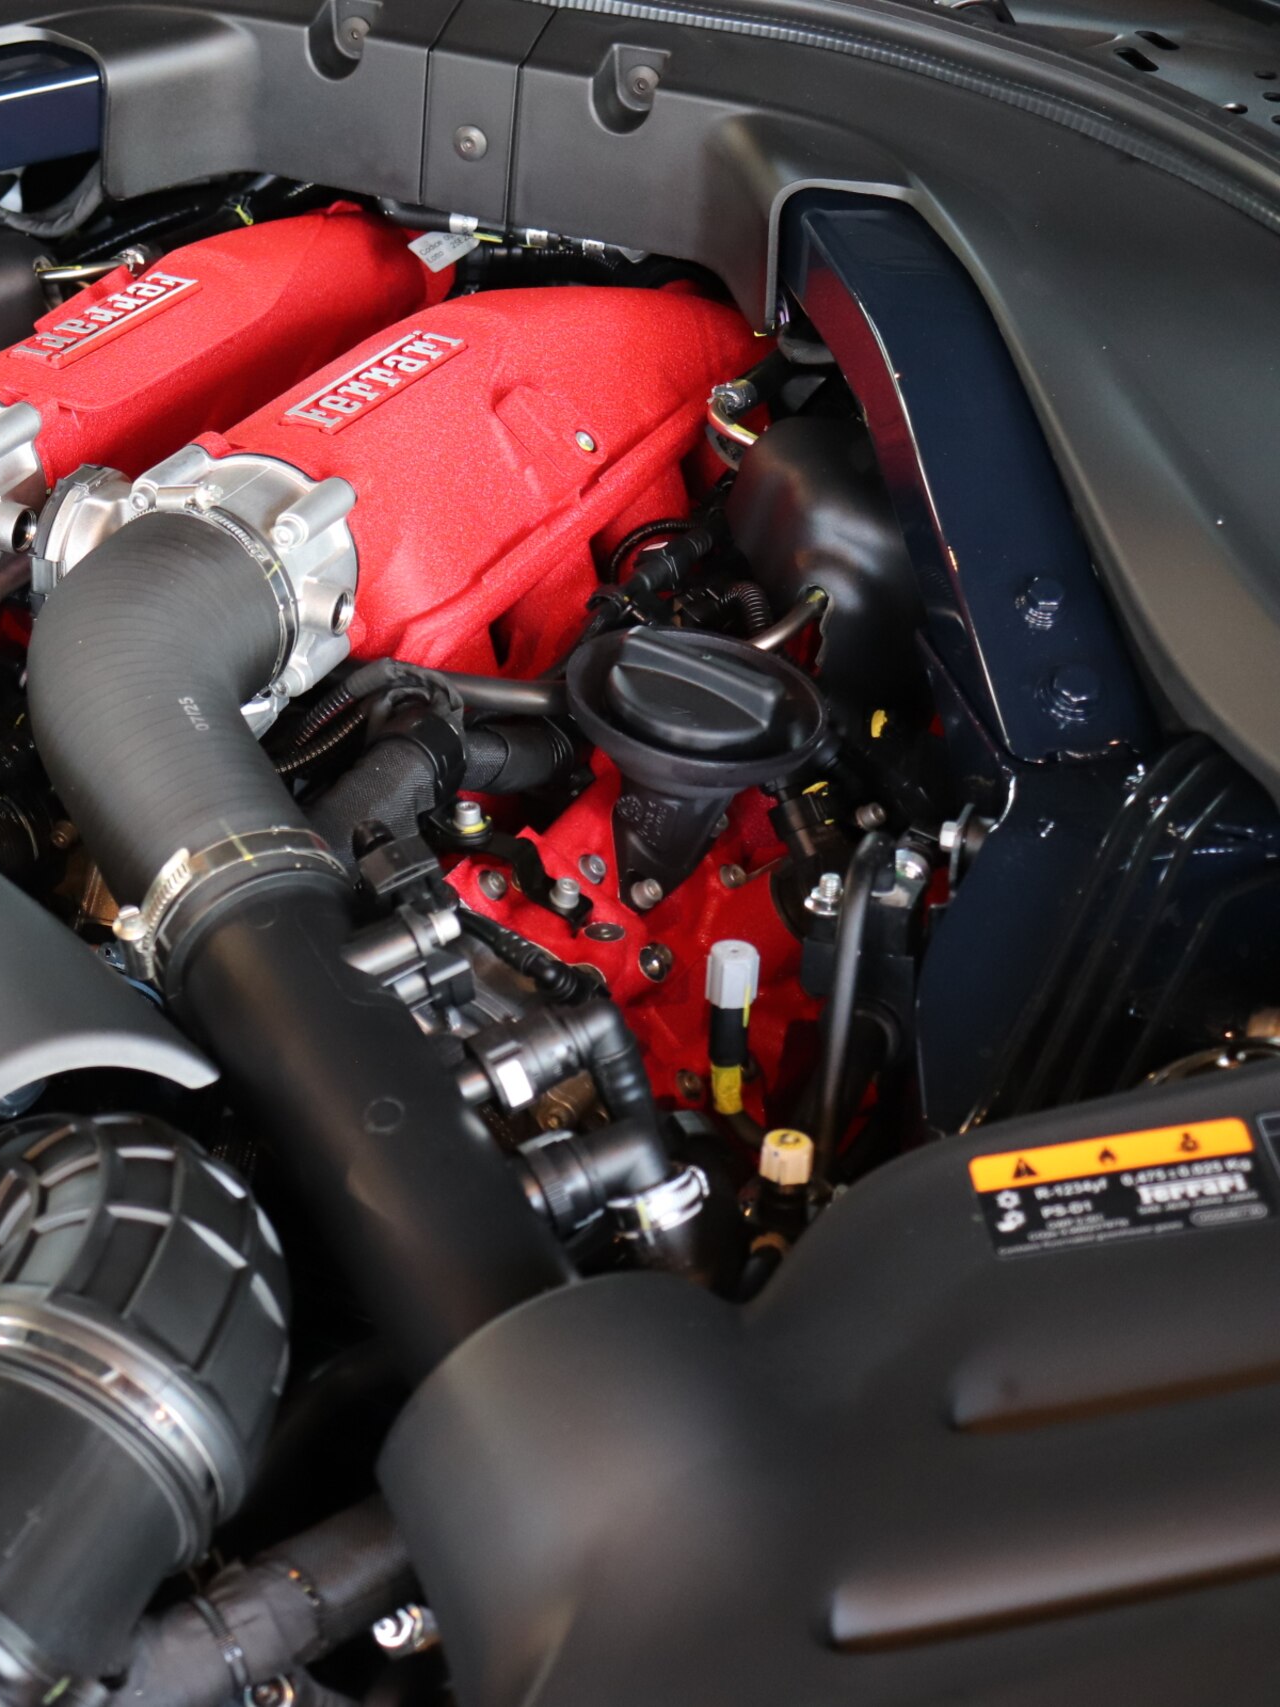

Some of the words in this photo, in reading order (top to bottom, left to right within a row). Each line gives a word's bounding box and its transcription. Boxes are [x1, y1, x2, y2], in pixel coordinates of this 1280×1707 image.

[12, 271, 199, 358] Ferrari
[284, 330, 465, 429] Ferrari
[178, 696, 209, 731] 07/25
[1136, 1172, 1248, 1205] Ferrari
